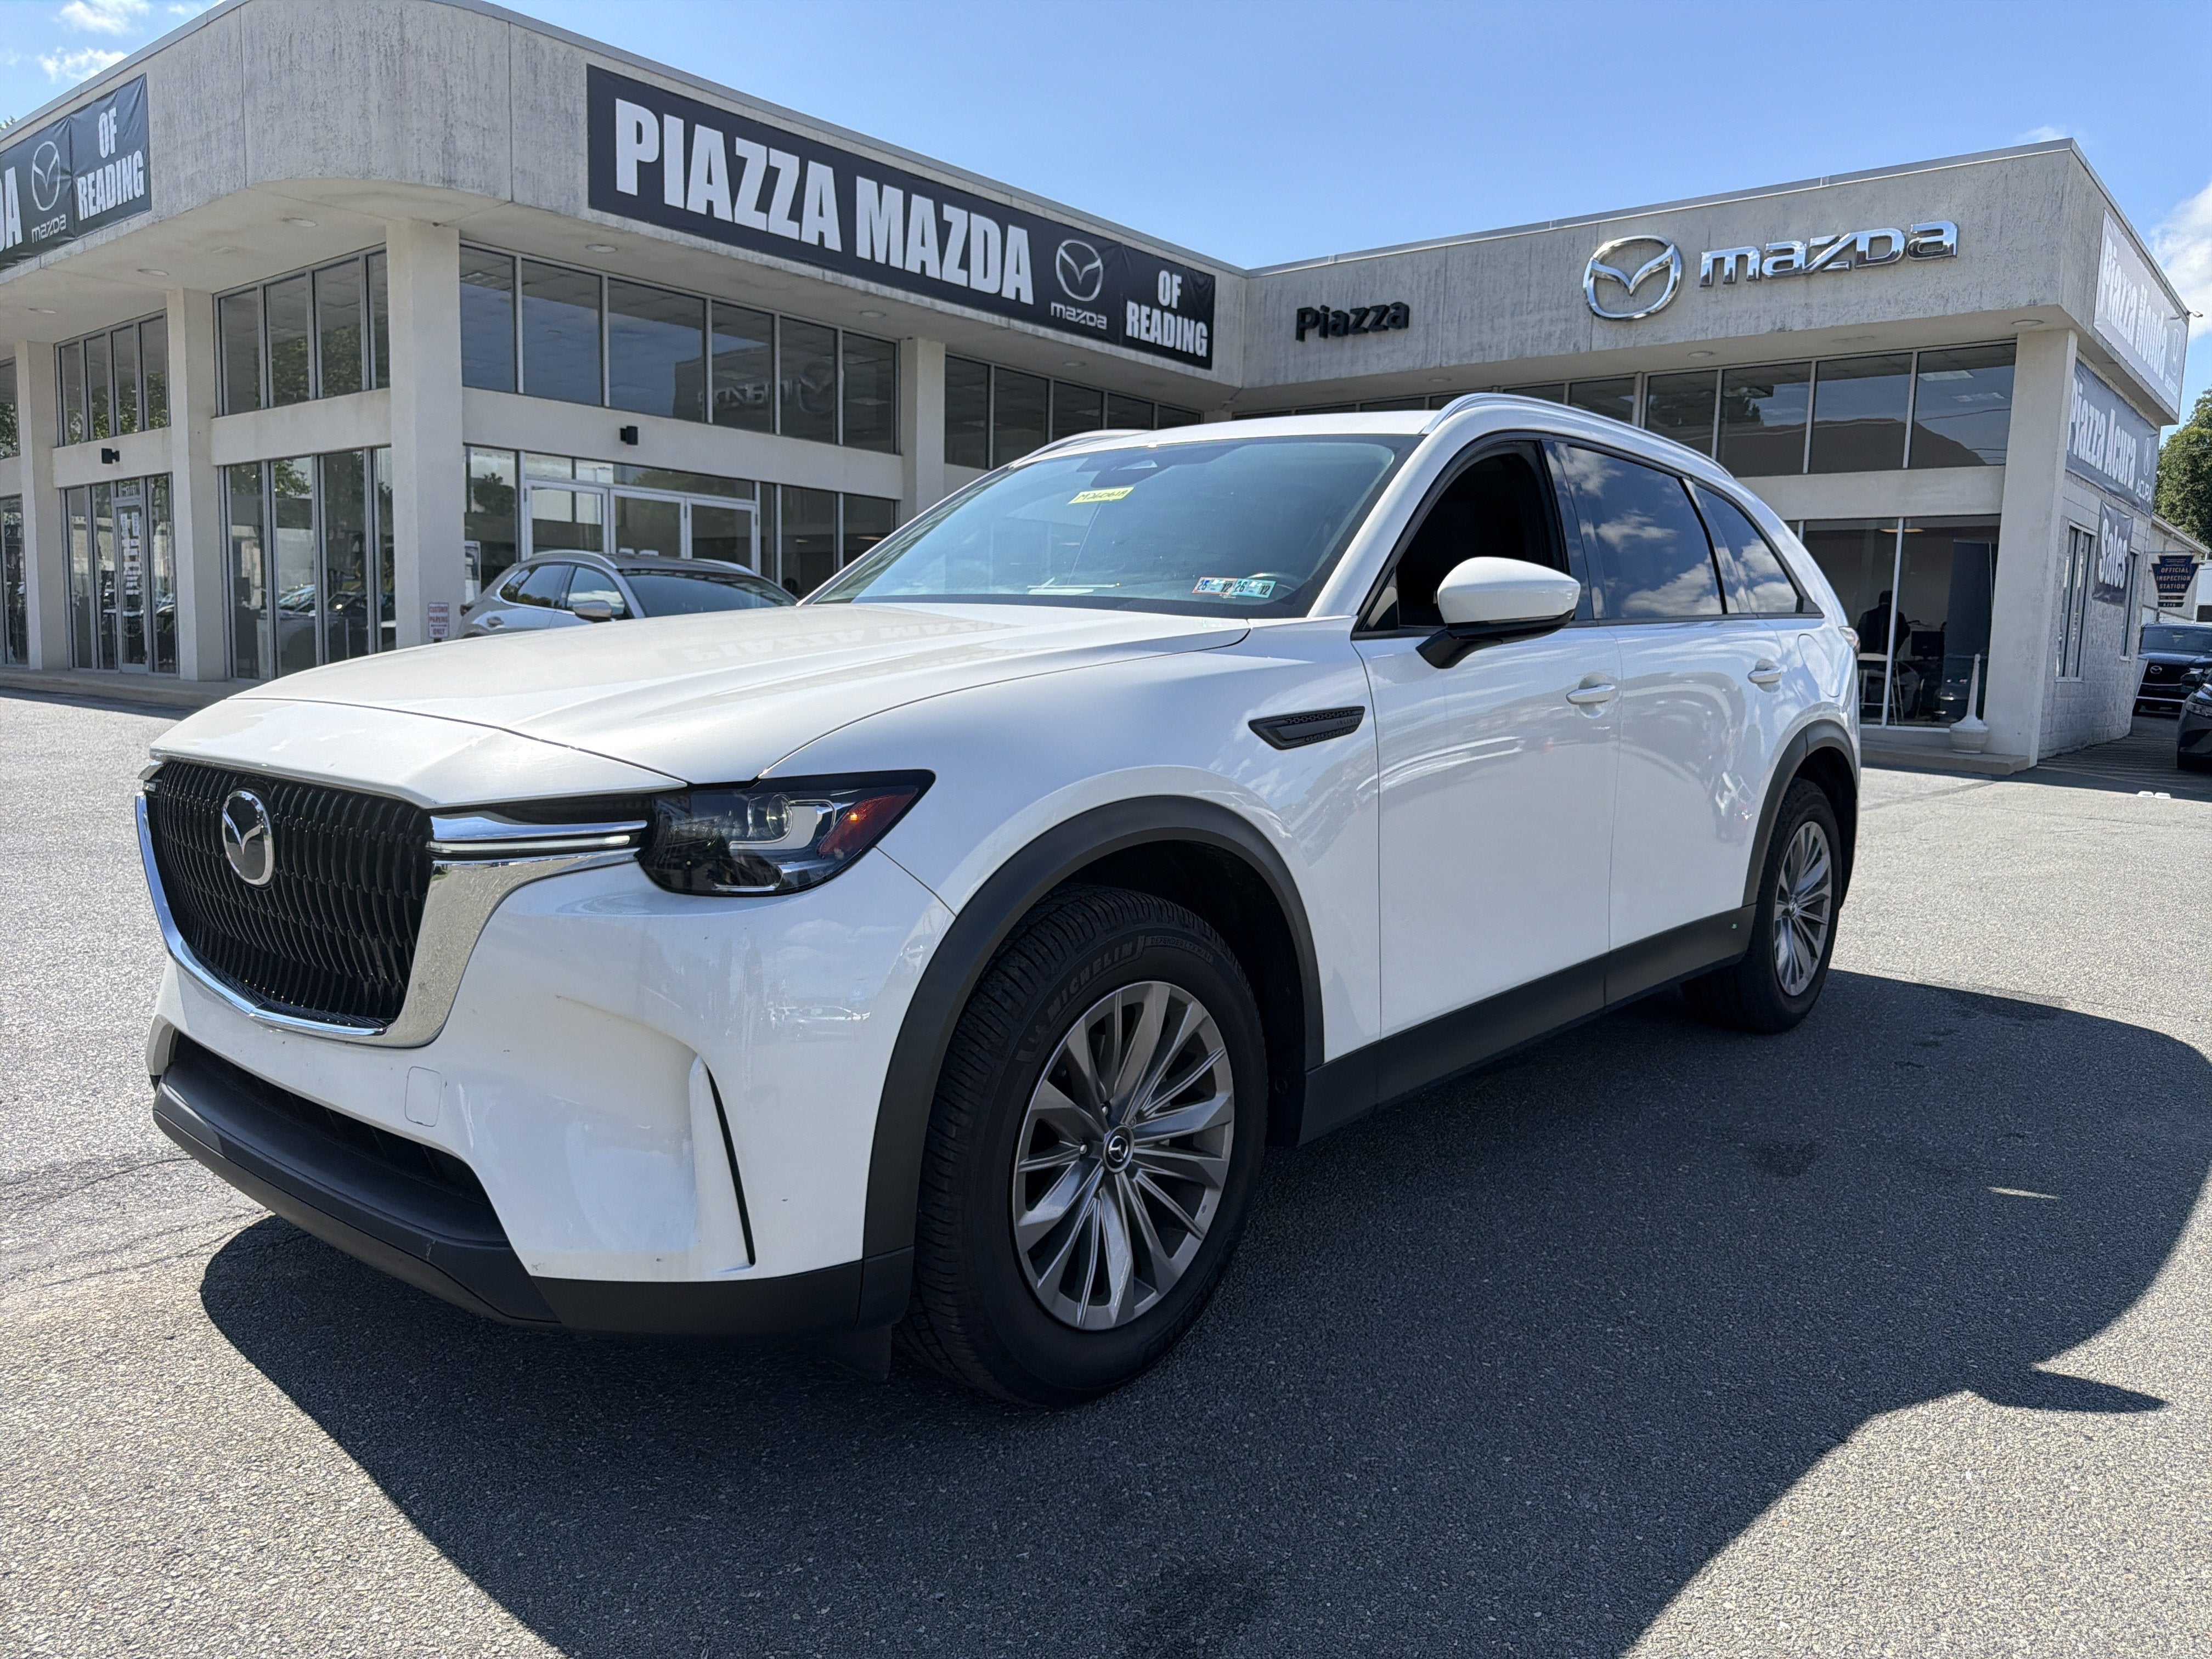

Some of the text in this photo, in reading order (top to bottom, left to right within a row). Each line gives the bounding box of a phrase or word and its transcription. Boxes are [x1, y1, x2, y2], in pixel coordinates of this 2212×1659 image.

[98, 106, 117, 159] OF
[77, 150, 144, 221] READING
[615, 98, 1034, 306] PIAZZA MAZDA
[31, 213, 66, 244] mazda
[1700, 220, 1959, 287] mazda
[1051, 301, 1107, 330] mazda
[1157, 269, 1182, 308] OF
[2101, 235, 2137, 347] Piazza
[1125, 300, 1207, 358] READING
[1295, 301, 1410, 342] Piazza
[2103, 408, 2136, 490] Acura
[2135, 478, 2152, 504] ACURA
[2098, 518, 2128, 589] Sales
[1047, 941, 1133, 1023] MICHELIN
